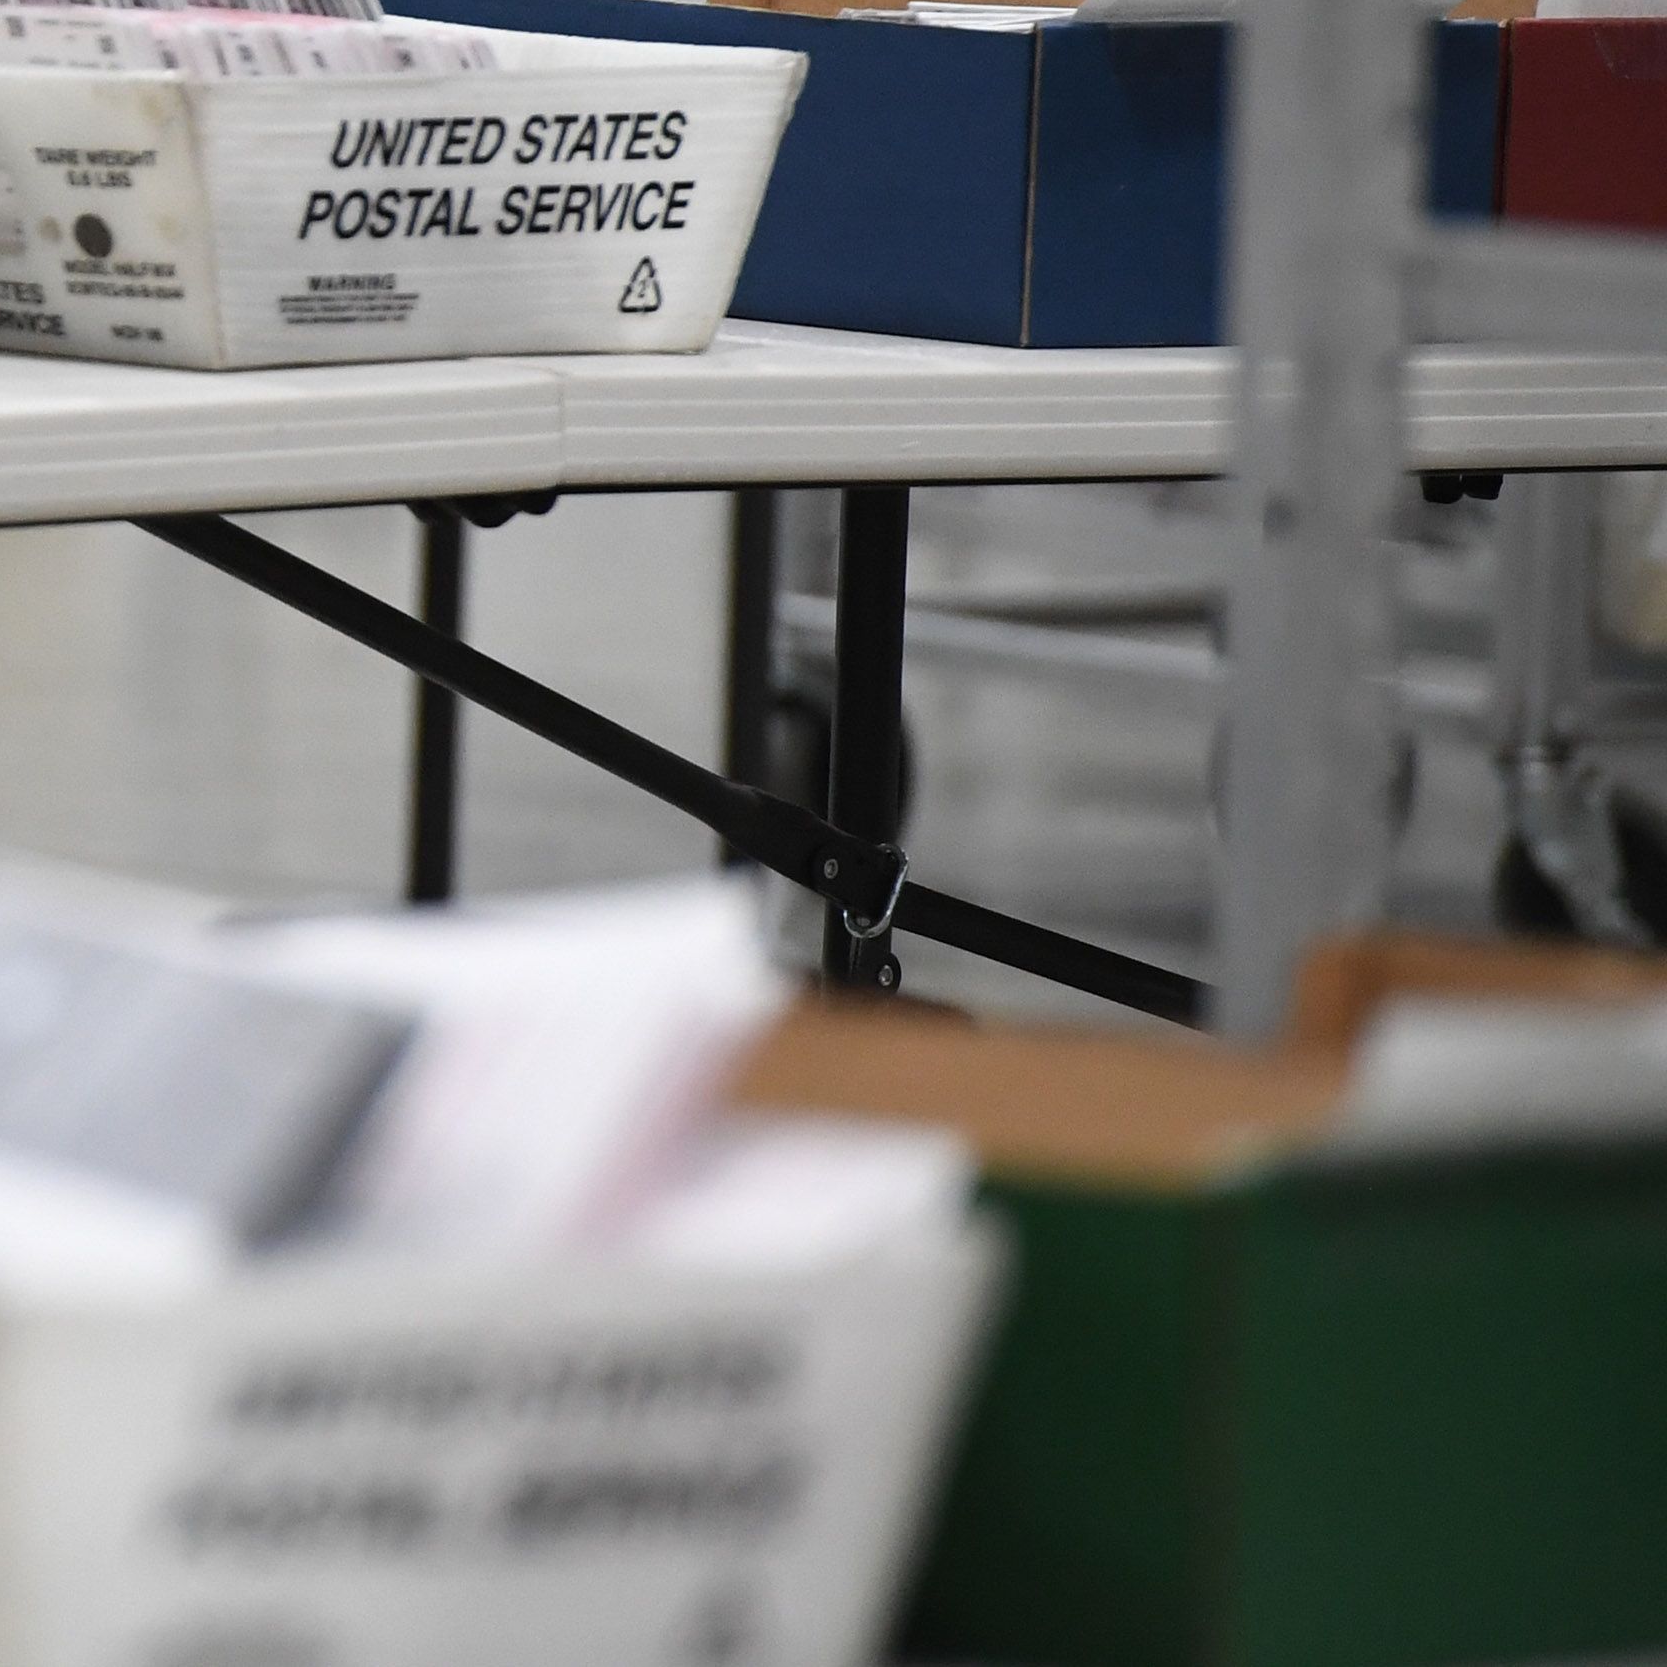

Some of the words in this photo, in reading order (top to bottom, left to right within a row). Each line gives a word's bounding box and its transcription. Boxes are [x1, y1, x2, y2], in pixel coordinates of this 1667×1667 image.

[330, 117, 506, 168] UNITED
[514, 111, 688, 165] STATES
[299, 187, 480, 239] POSTAL
[496, 181, 695, 235] SERVICE
[307, 273, 396, 291] WARNING
